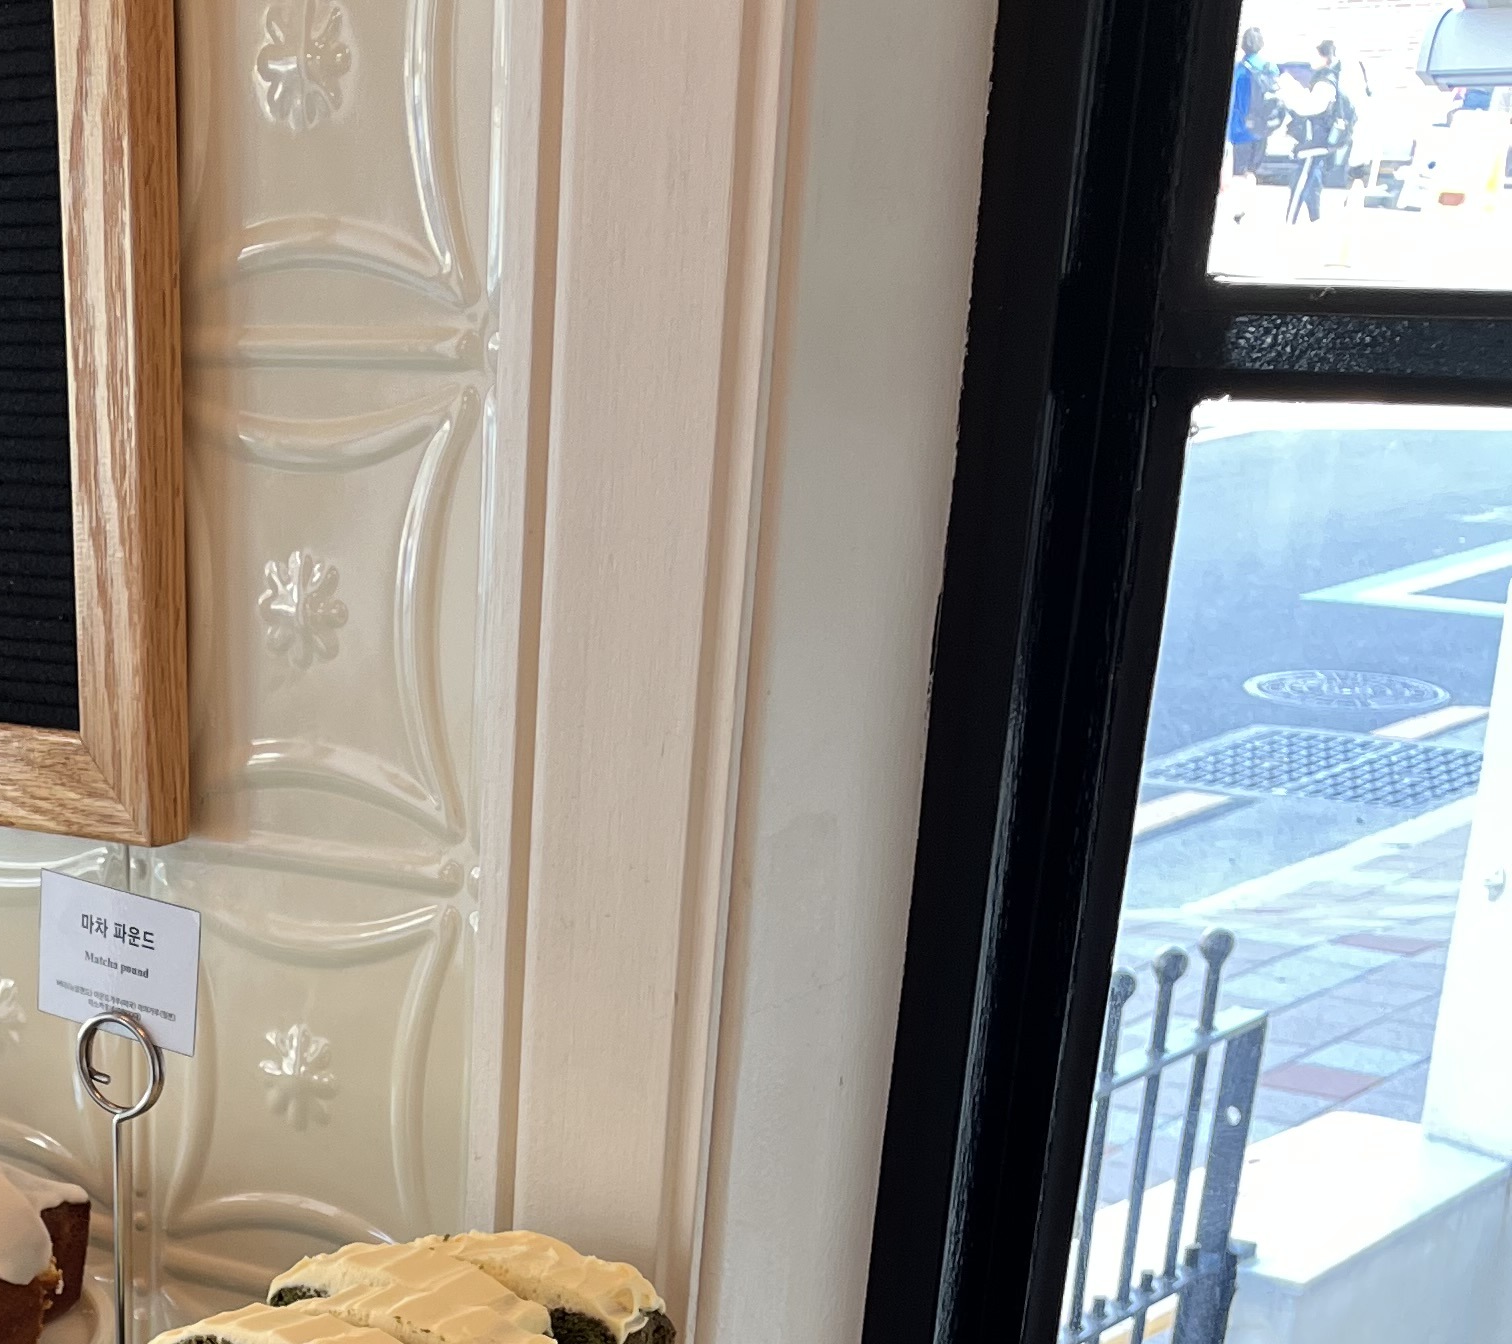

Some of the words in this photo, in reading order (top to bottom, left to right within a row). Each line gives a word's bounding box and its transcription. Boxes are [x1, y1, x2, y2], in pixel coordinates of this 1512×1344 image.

[81, 912, 108, 938] 마차
[114, 922, 154, 951] 파운드
[84, 951, 118, 969] Matcha
[121, 963, 148, 979] pound
